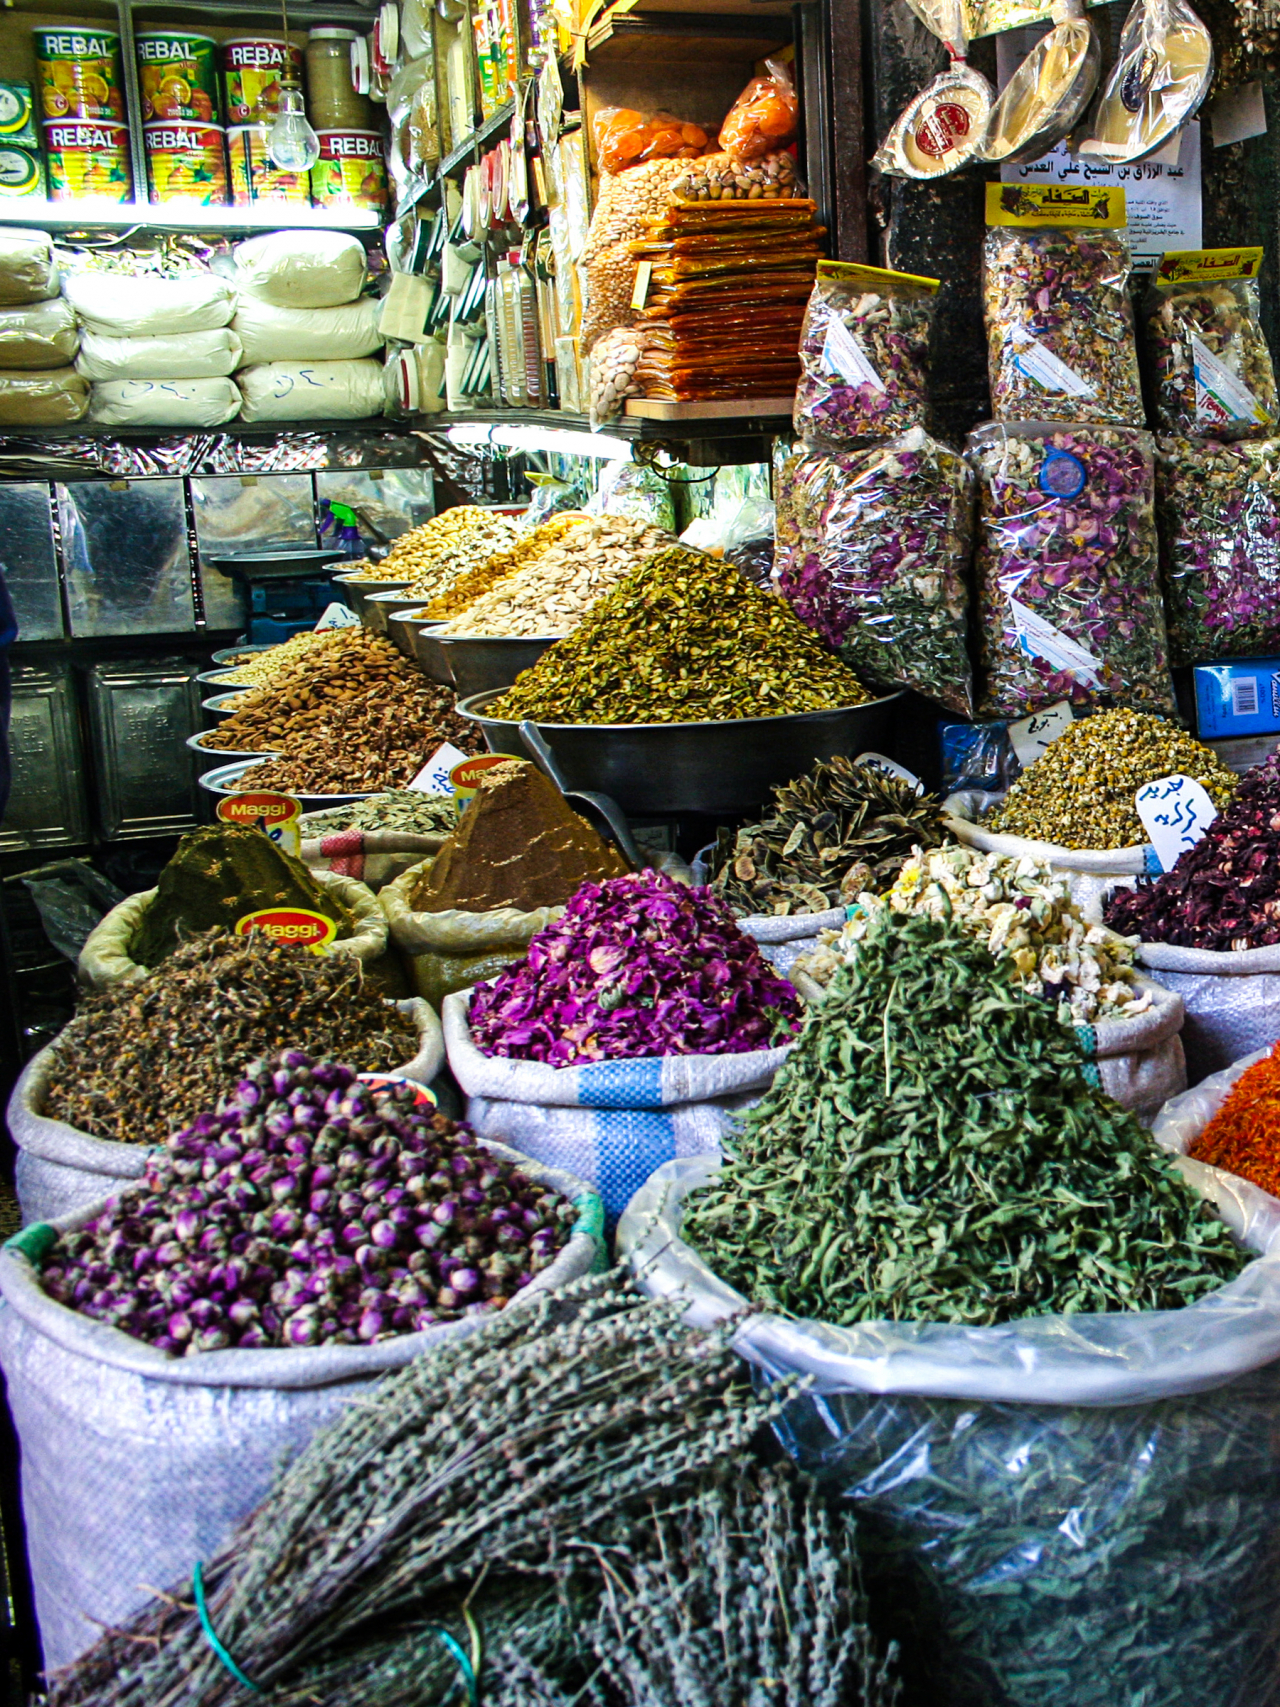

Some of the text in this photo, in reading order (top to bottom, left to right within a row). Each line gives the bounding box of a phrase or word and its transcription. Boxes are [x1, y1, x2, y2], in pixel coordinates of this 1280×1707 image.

[45, 36, 113, 58] REBAL
[137, 41, 197, 60] REBAL
[232, 47, 288, 65] REBA
[51, 128, 118, 148] REBAL
[146, 131, 204, 150] REBAL
[329, 137, 383, 157] REBAL
[1058, 163, 1080, 181] علي
[1083, 163, 1114, 180] الشيخ
[1118, 166, 1131, 180] بن
[1133, 163, 1163, 179] الرزاق
[1167, 166, 1184, 180] عبد
[231, 803, 286, 817] Maggi
[253, 921, 318, 939] Maggi
